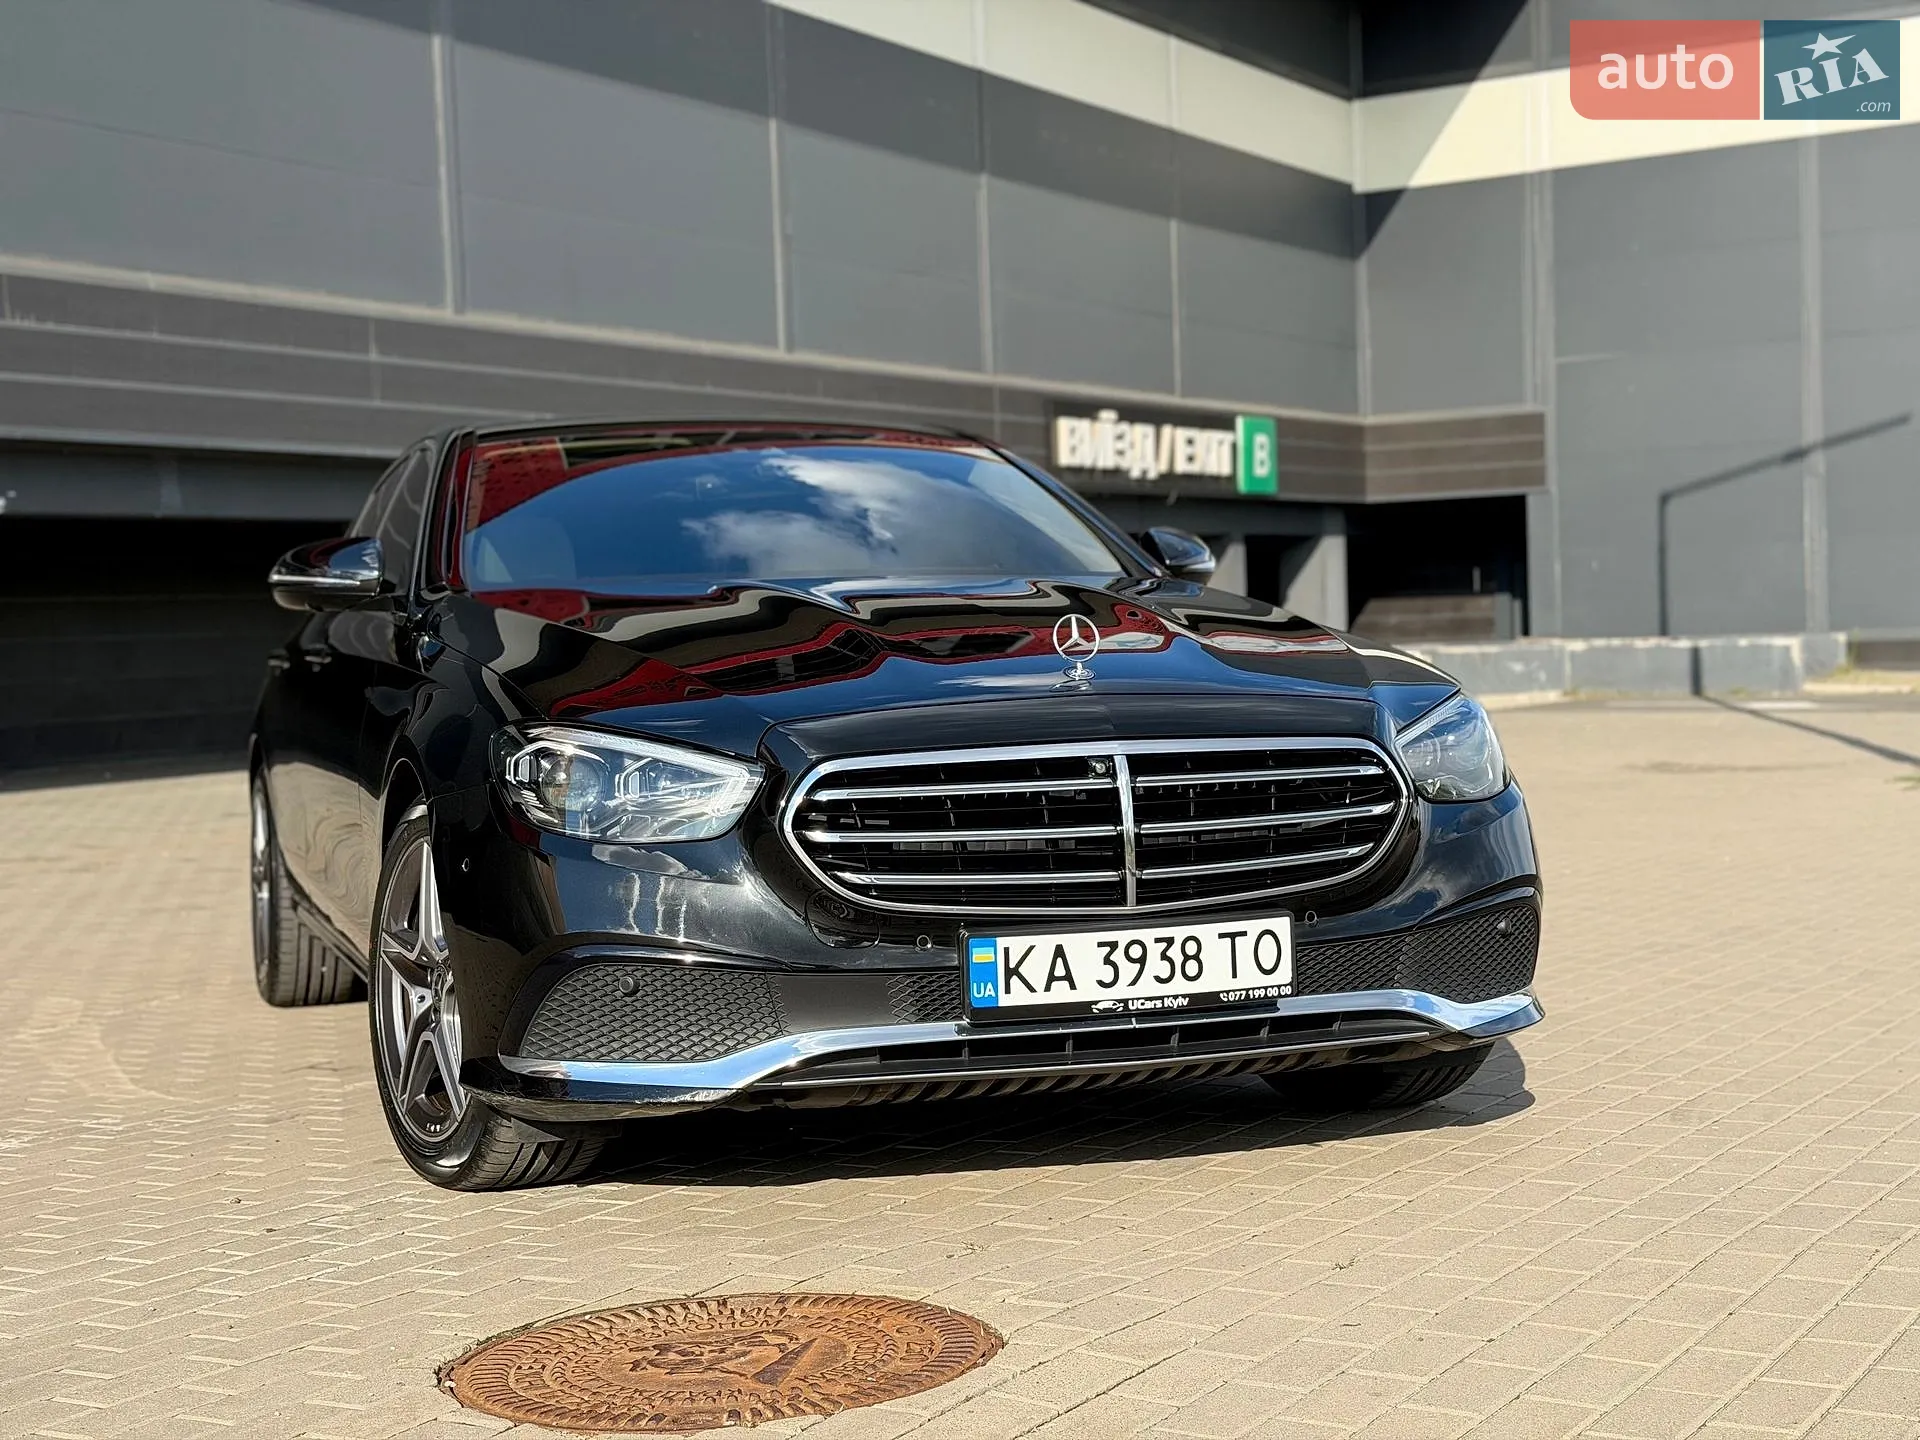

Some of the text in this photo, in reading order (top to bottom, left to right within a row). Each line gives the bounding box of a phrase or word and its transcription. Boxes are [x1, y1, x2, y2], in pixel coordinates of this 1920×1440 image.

[1003, 929, 1282, 995] KA 3938 TO
[973, 982, 996, 998] UA
[1229, 985, 1291, 1001] 077 199 00 00
[1129, 996, 1189, 1010] UCars Kyiv
